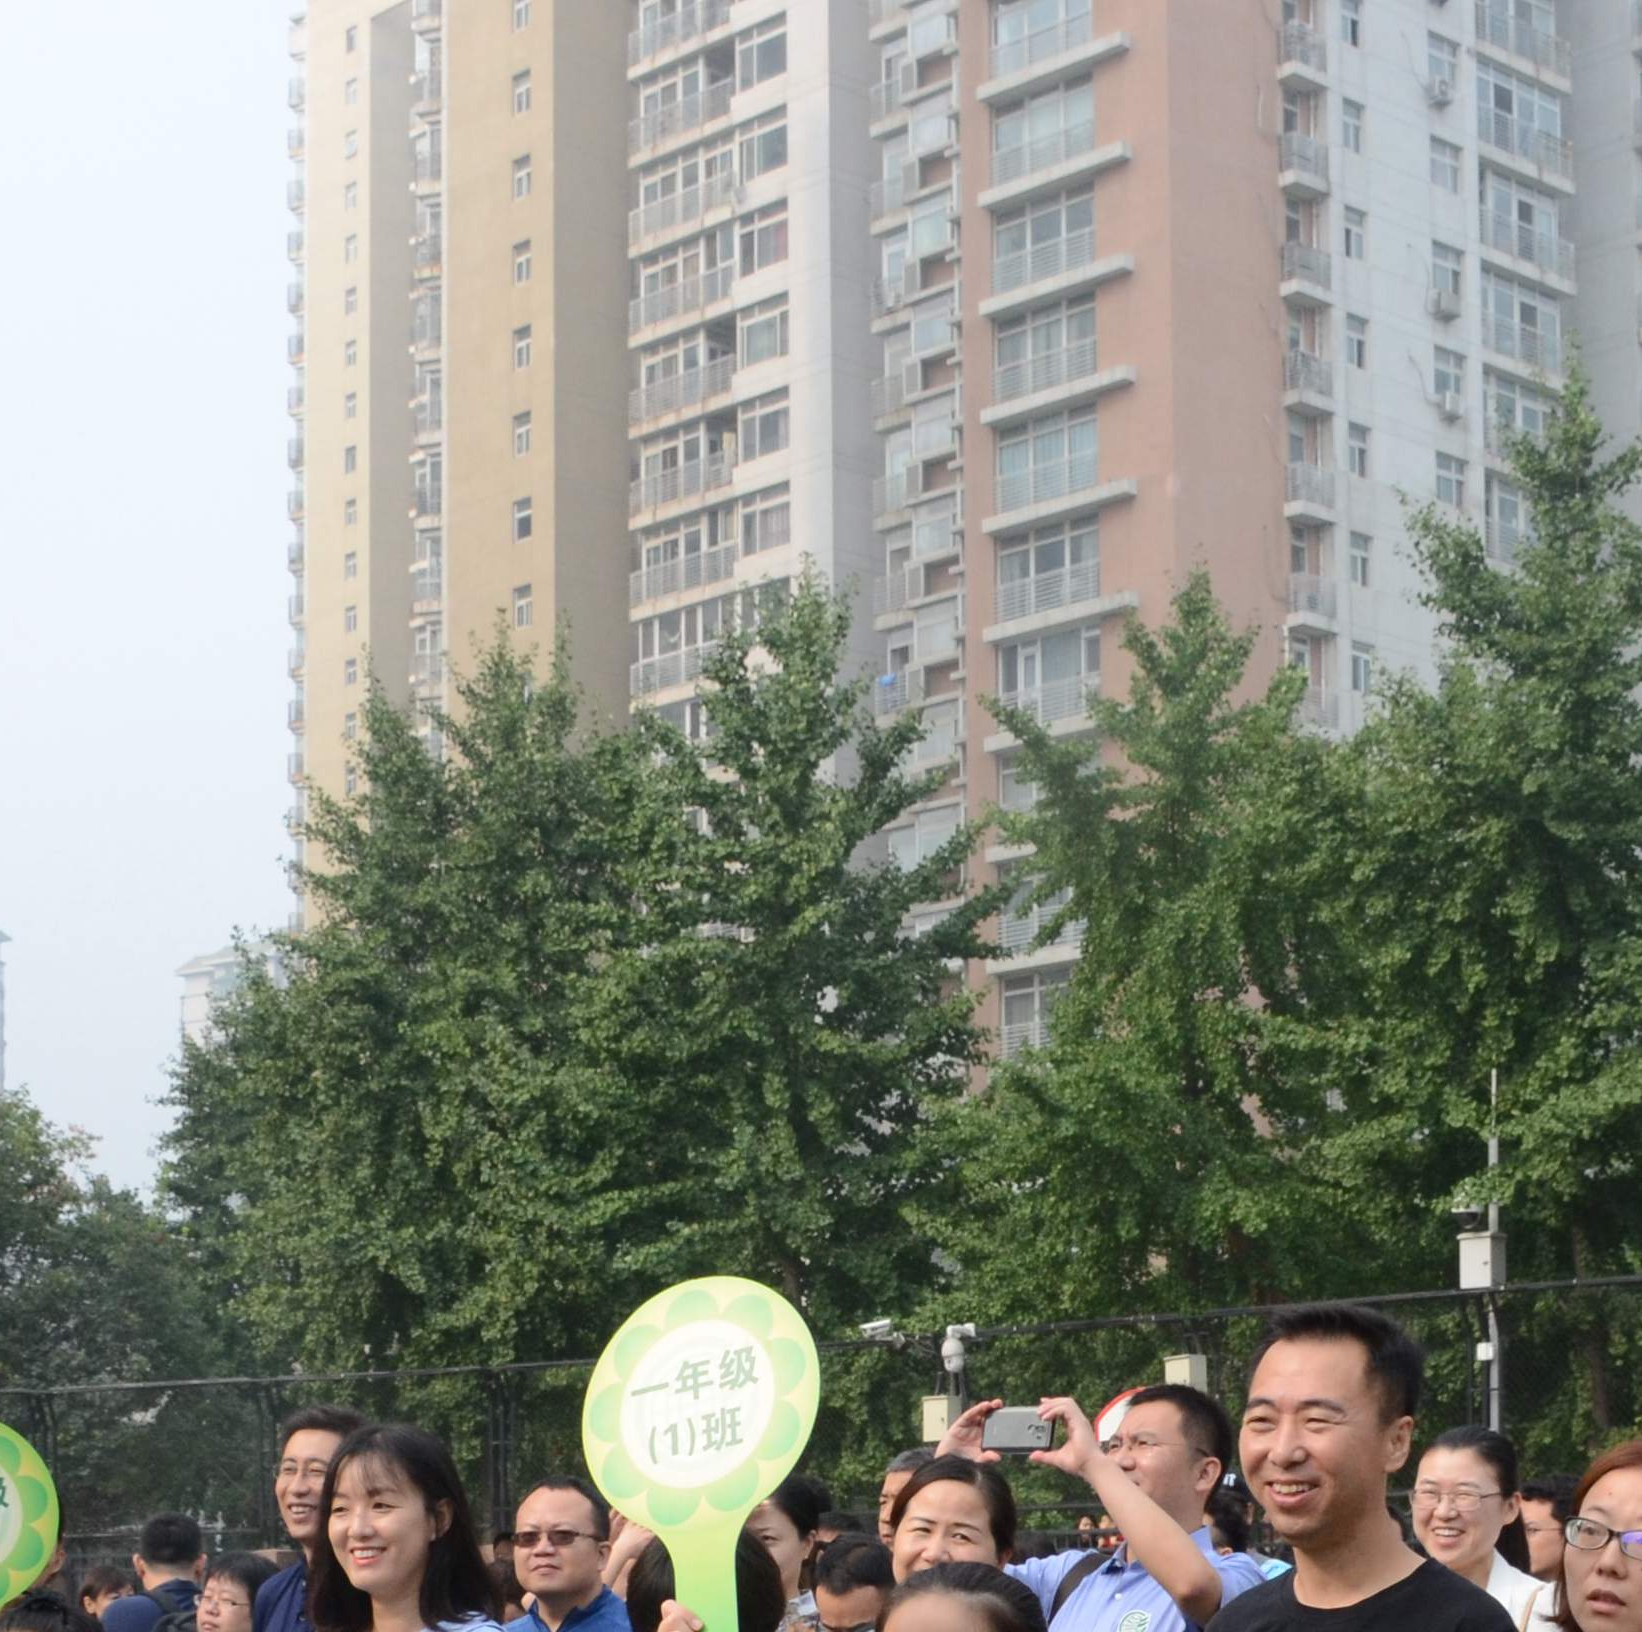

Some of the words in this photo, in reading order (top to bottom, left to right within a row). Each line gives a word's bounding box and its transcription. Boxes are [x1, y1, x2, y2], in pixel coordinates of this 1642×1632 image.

[630, 1345, 759, 1400] 一年级
[647, 1406, 744, 1465] (1)班
